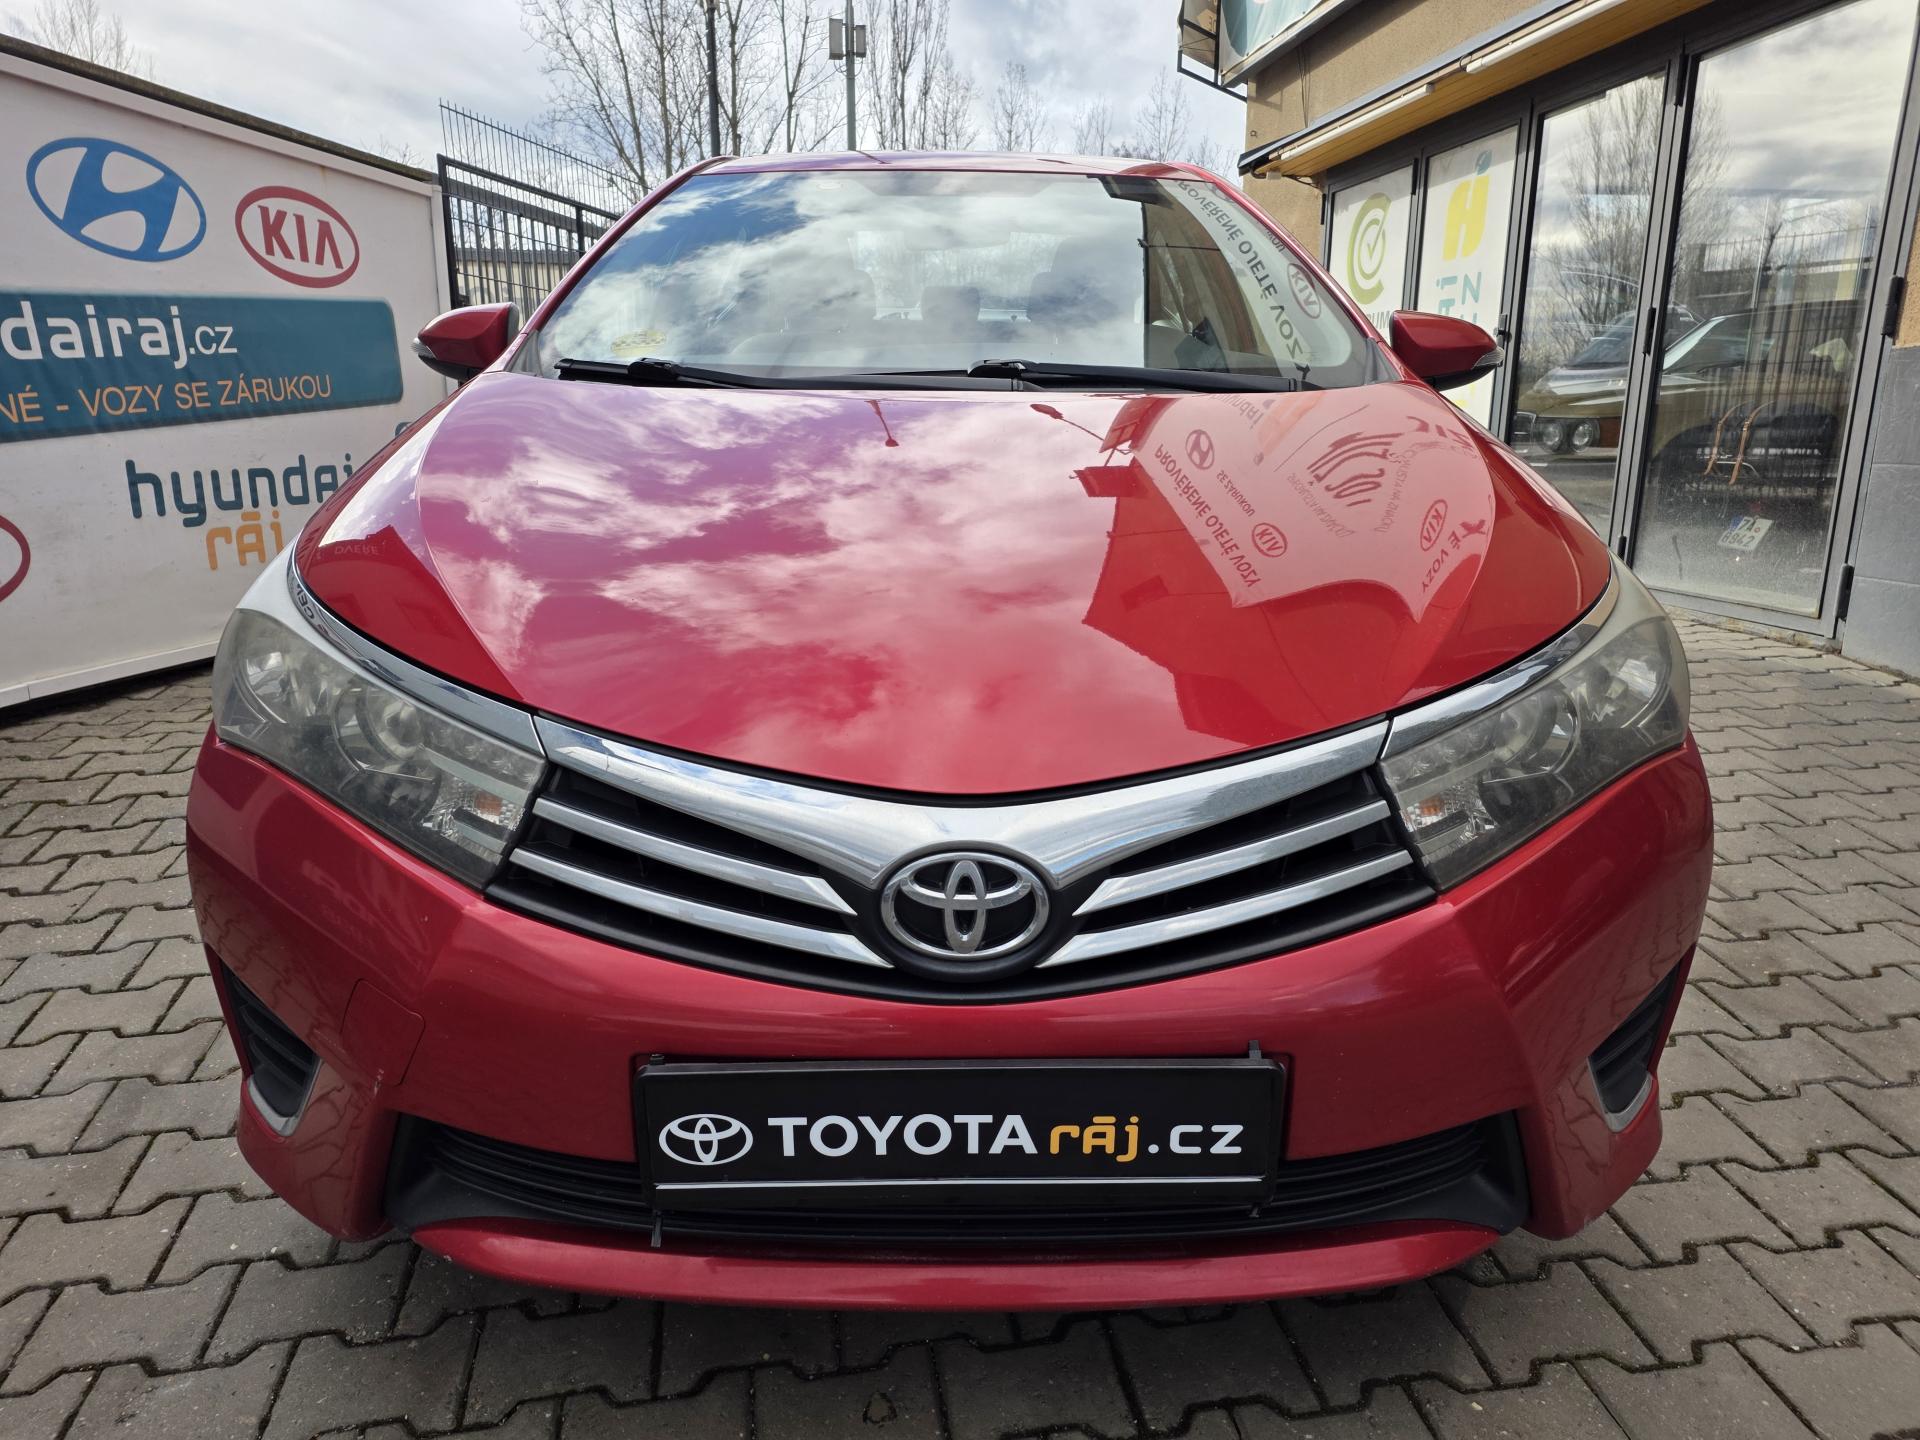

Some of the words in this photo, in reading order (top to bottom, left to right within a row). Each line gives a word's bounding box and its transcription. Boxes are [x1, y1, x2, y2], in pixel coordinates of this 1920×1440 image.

[258, 205, 344, 270] KIA
[78, 384, 163, 417] VOZY
[175, 381, 211, 409] SE
[217, 373, 332, 405] ZÁRUKOU
[767, 1114, 1038, 1158] TOYOTA
